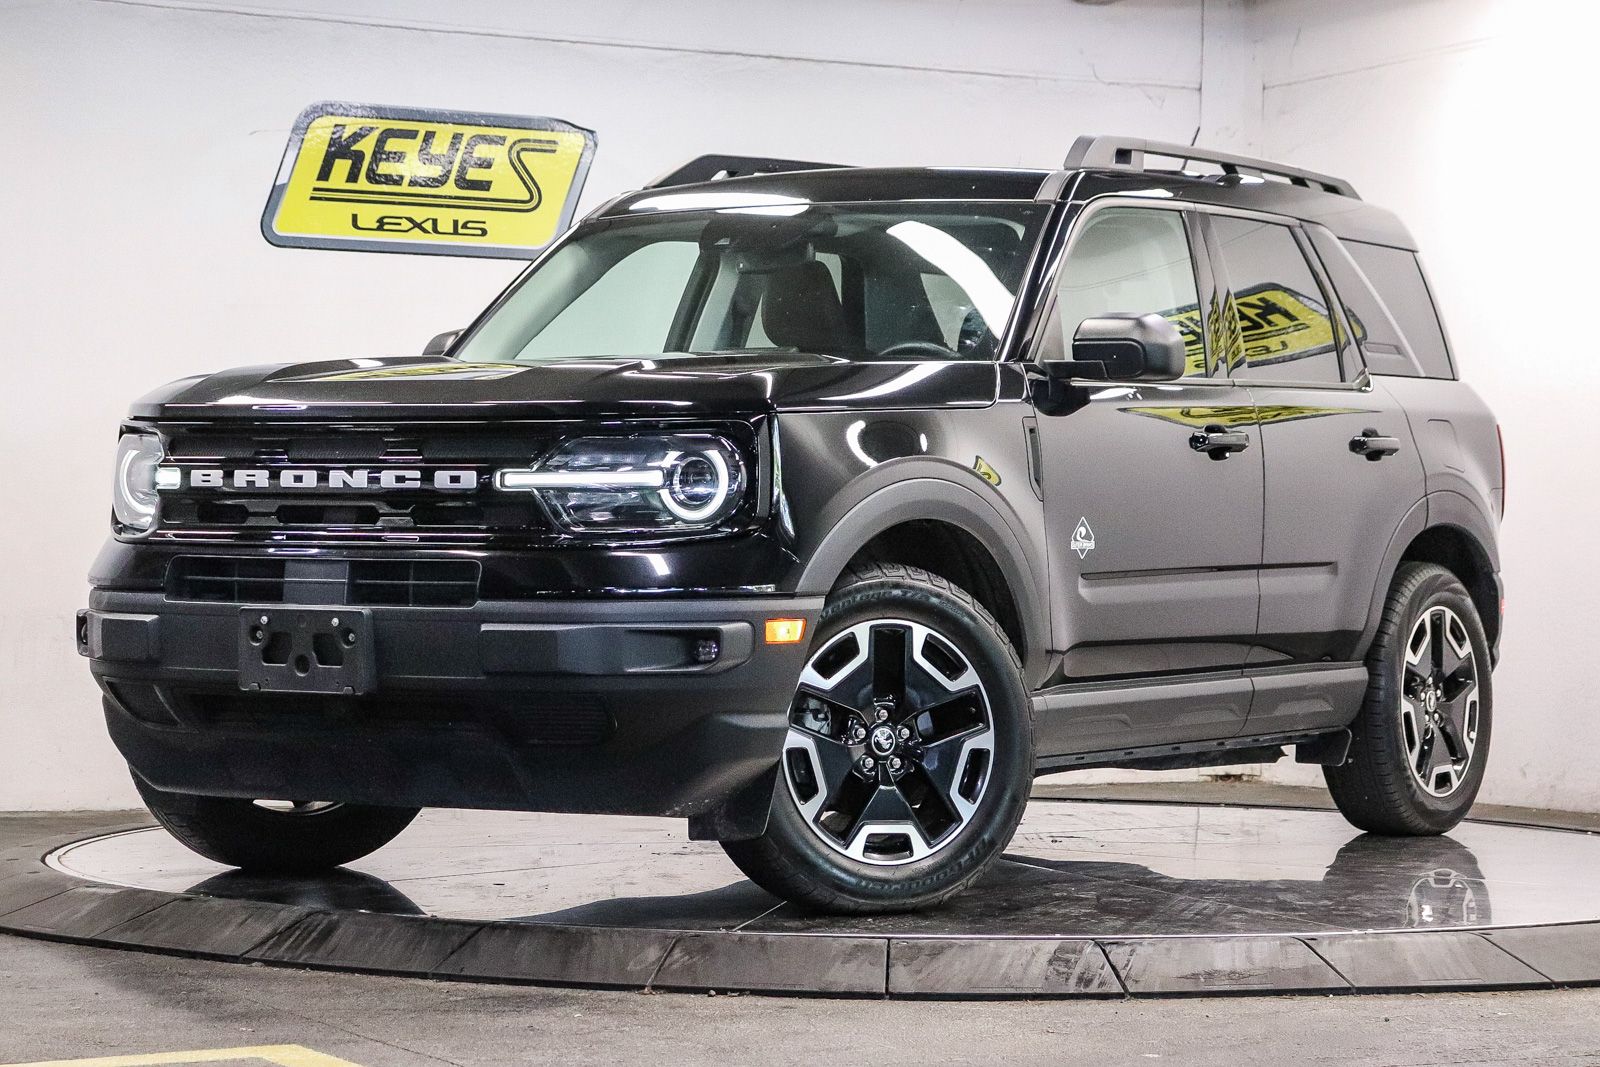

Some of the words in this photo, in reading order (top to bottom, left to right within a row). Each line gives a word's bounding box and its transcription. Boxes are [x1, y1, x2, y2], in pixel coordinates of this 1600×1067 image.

[310, 124, 559, 212] KEYES
[351, 213, 488, 237] LEXUS
[190, 469, 477, 489] BRONCO
